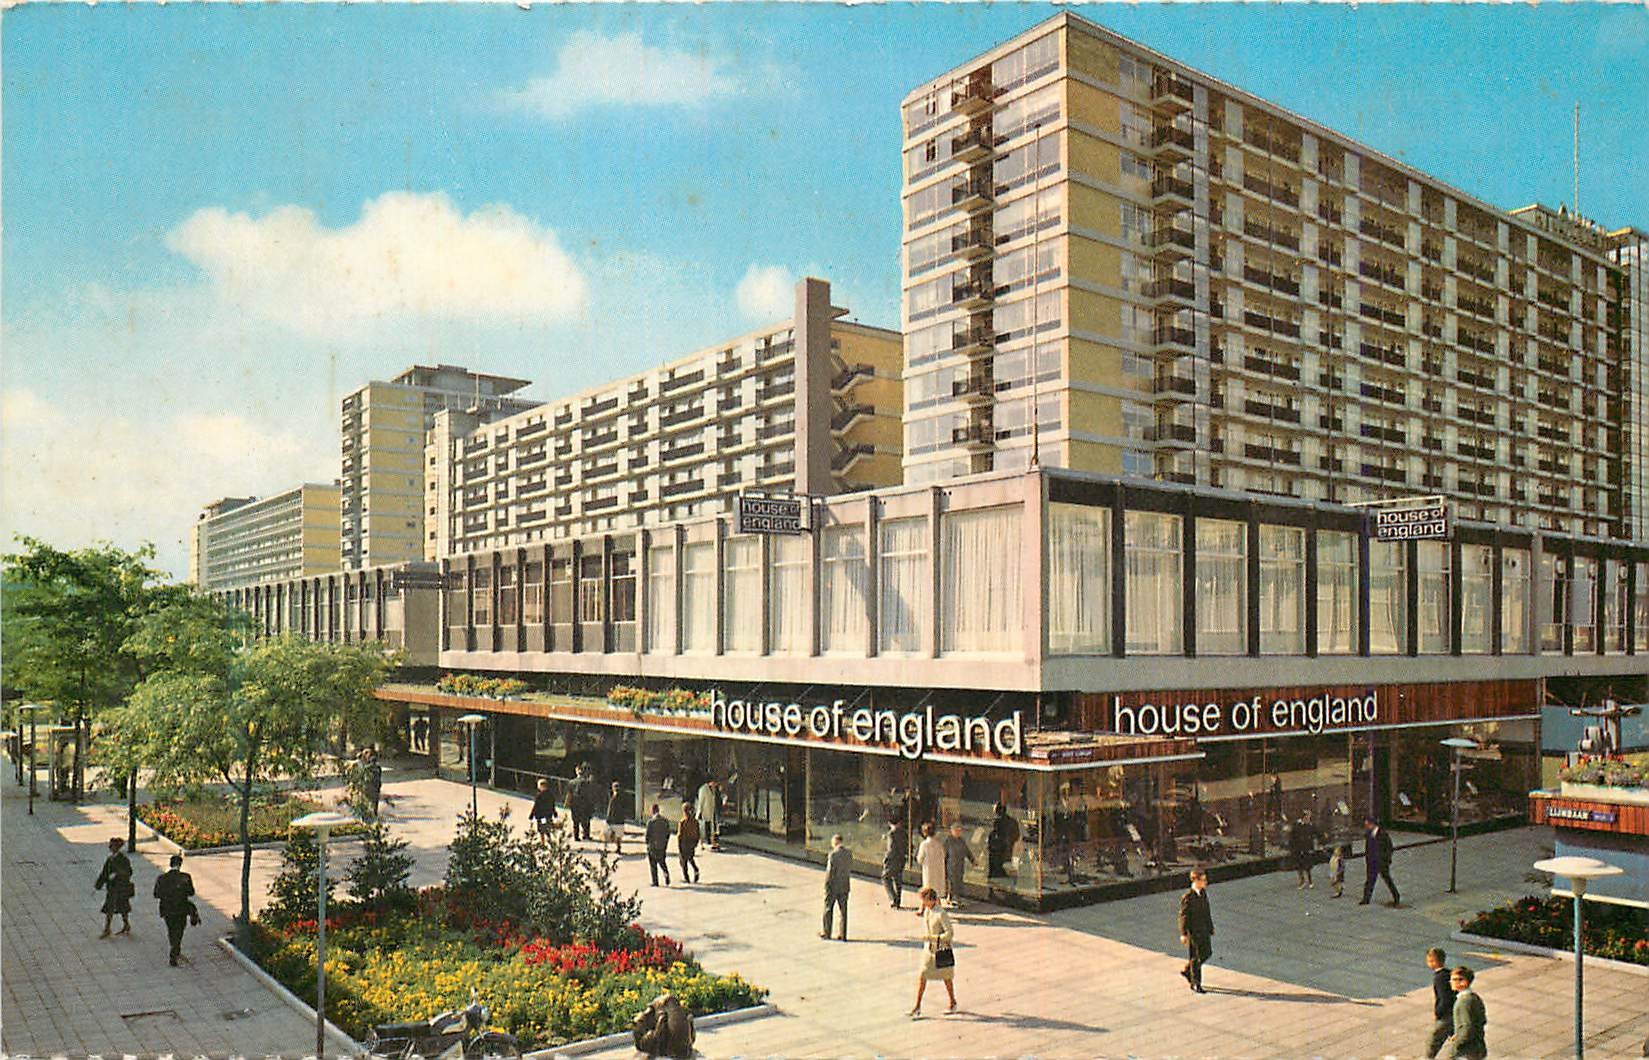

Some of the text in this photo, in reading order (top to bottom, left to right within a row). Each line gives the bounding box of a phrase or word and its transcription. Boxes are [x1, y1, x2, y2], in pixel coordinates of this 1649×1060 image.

[743, 501, 788, 516] house
[1378, 505, 1444, 524] house of
[1378, 520, 1445, 538] england
[1115, 690, 1378, 734] house of england
[711, 688, 1022, 759] house of england
